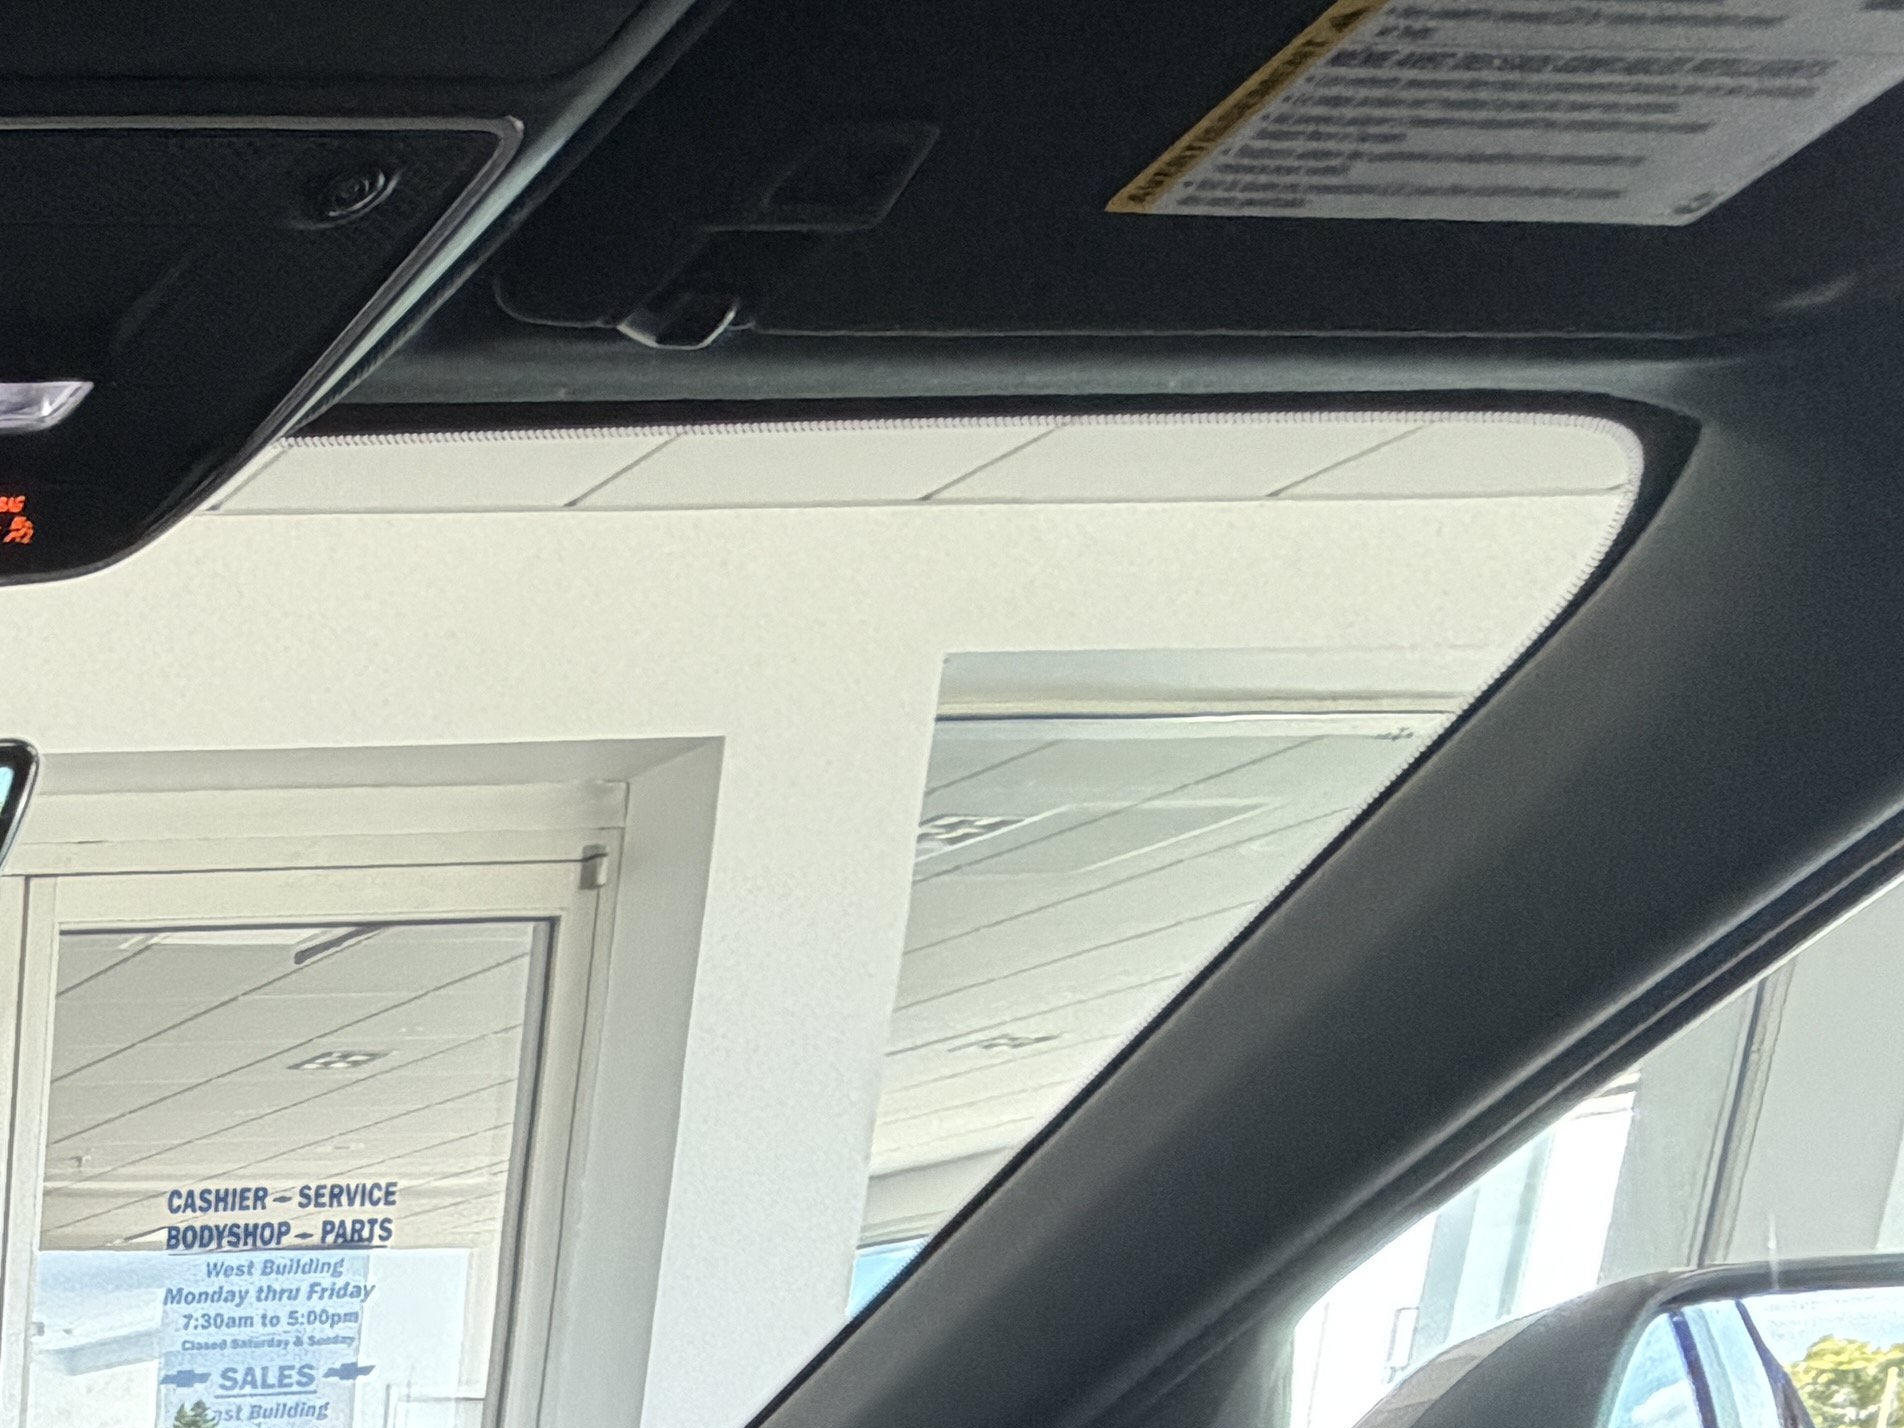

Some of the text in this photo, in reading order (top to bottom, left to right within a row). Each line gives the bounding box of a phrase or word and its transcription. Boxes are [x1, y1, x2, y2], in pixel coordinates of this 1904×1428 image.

[166, 1181, 398, 1214] CASHIER SERVICE
[166, 1217, 394, 1251] BODYSHOP PARTS
[206, 1258, 346, 1279] West Building
[163, 1281, 376, 1308] Monday thru Friday
[182, 1309, 359, 1331] 7:30am to 5:00pm
[181, 1339, 228, 1352] Closed
[230, 1337, 290, 1350] Saturday
[218, 1364, 316, 1391] SALES
[248, 1401, 330, 1422] Building
